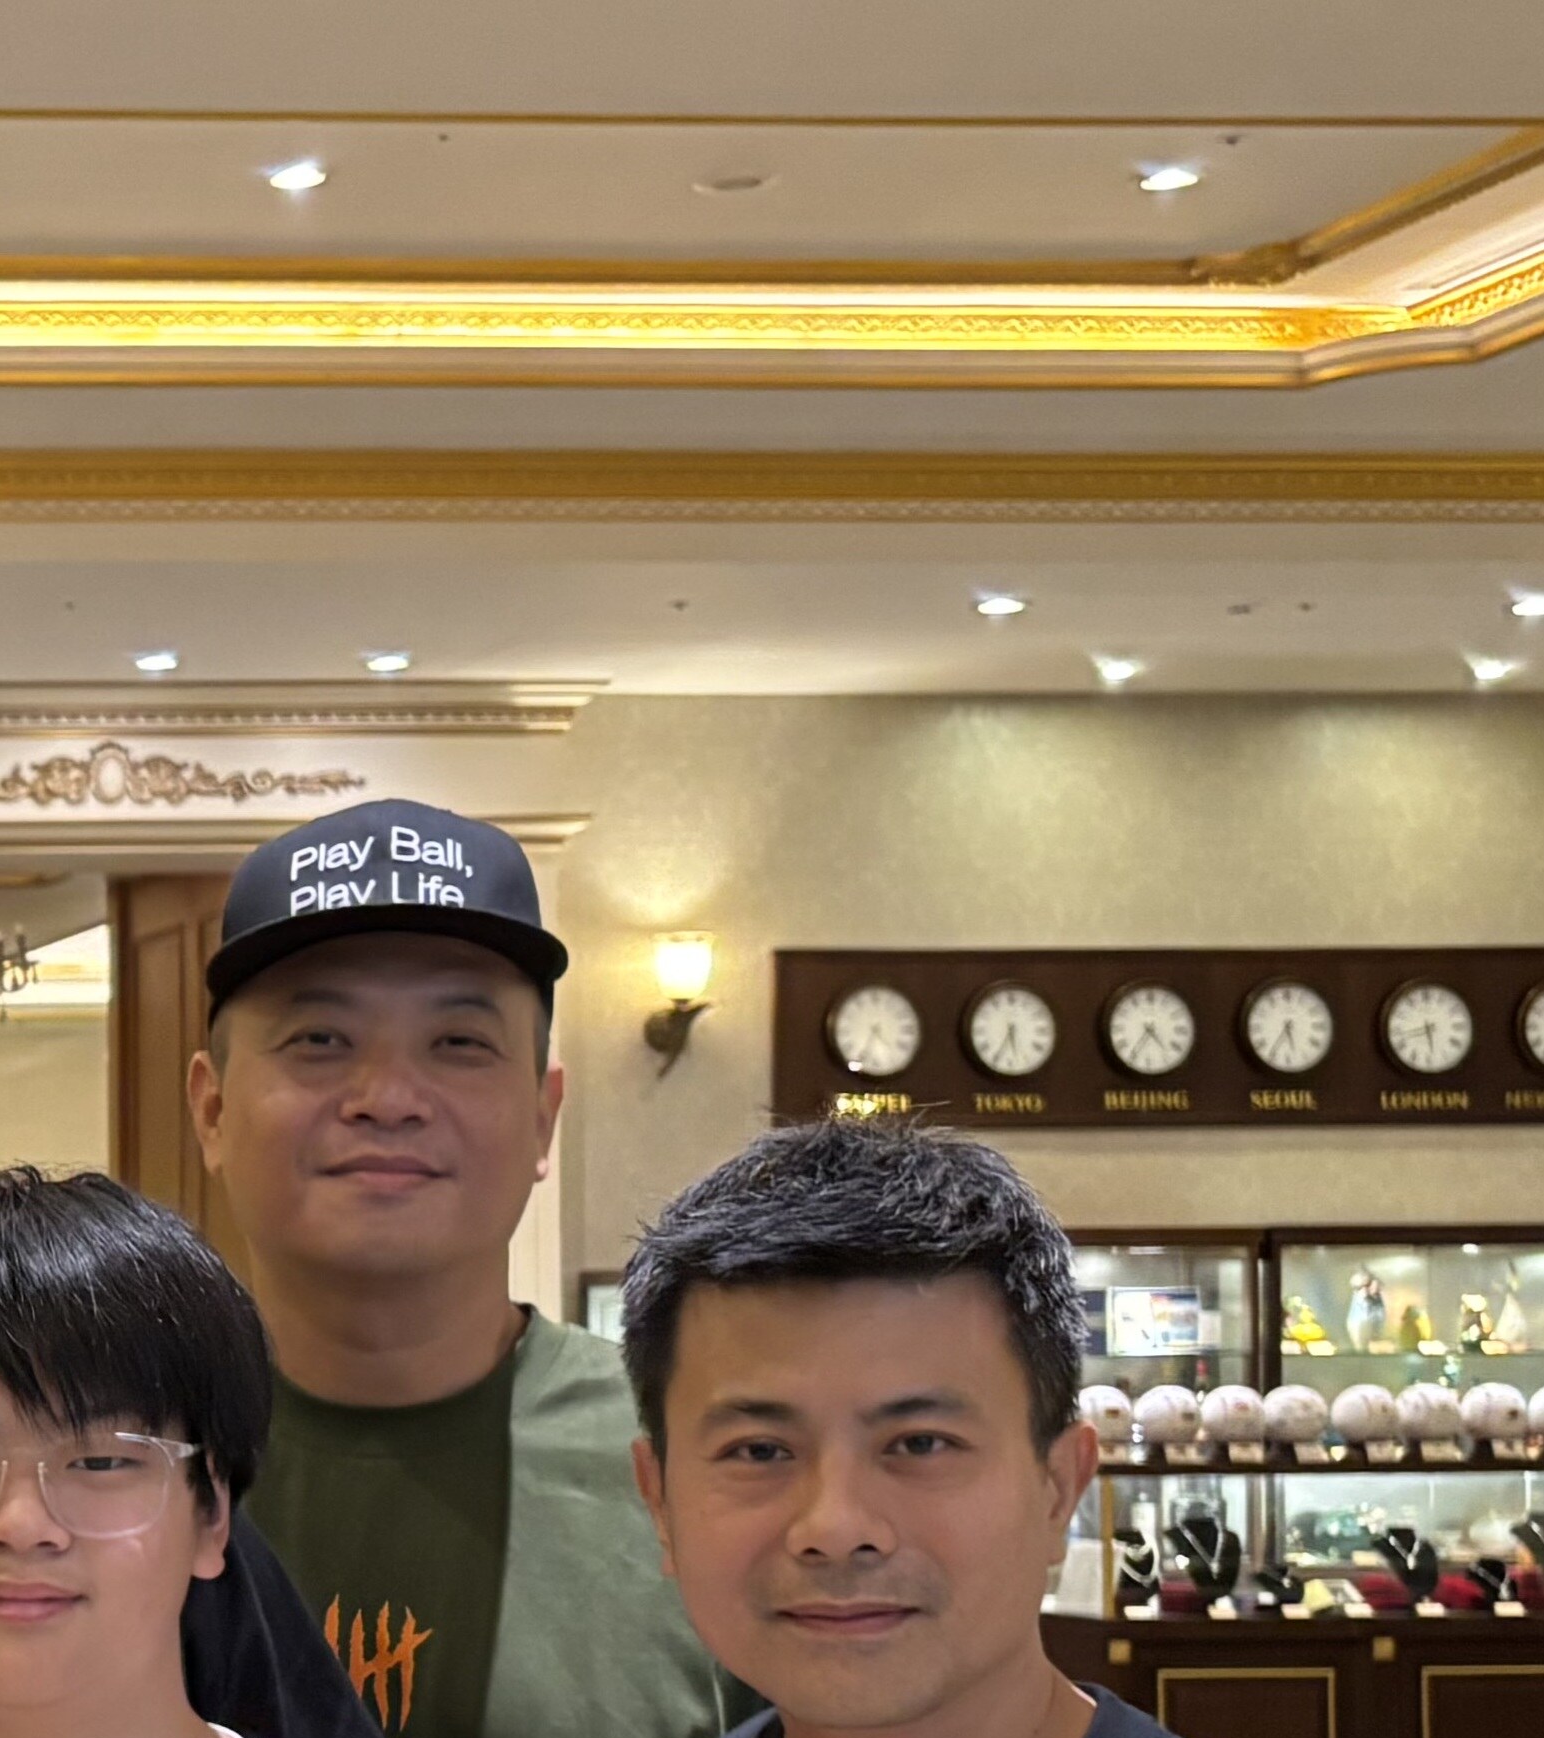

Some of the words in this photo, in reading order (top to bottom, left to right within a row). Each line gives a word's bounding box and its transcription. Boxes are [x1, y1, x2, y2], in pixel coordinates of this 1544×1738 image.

[290, 835, 375, 881] Play
[390, 826, 474, 878] Ball,
[290, 878, 376, 907] Play
[973, 1093, 1046, 1113] TOKYO
[1104, 1090, 1190, 1111] BEIJING
[1250, 1089, 1318, 1111] SEOUL
[1380, 1090, 1470, 1110] LONDON
